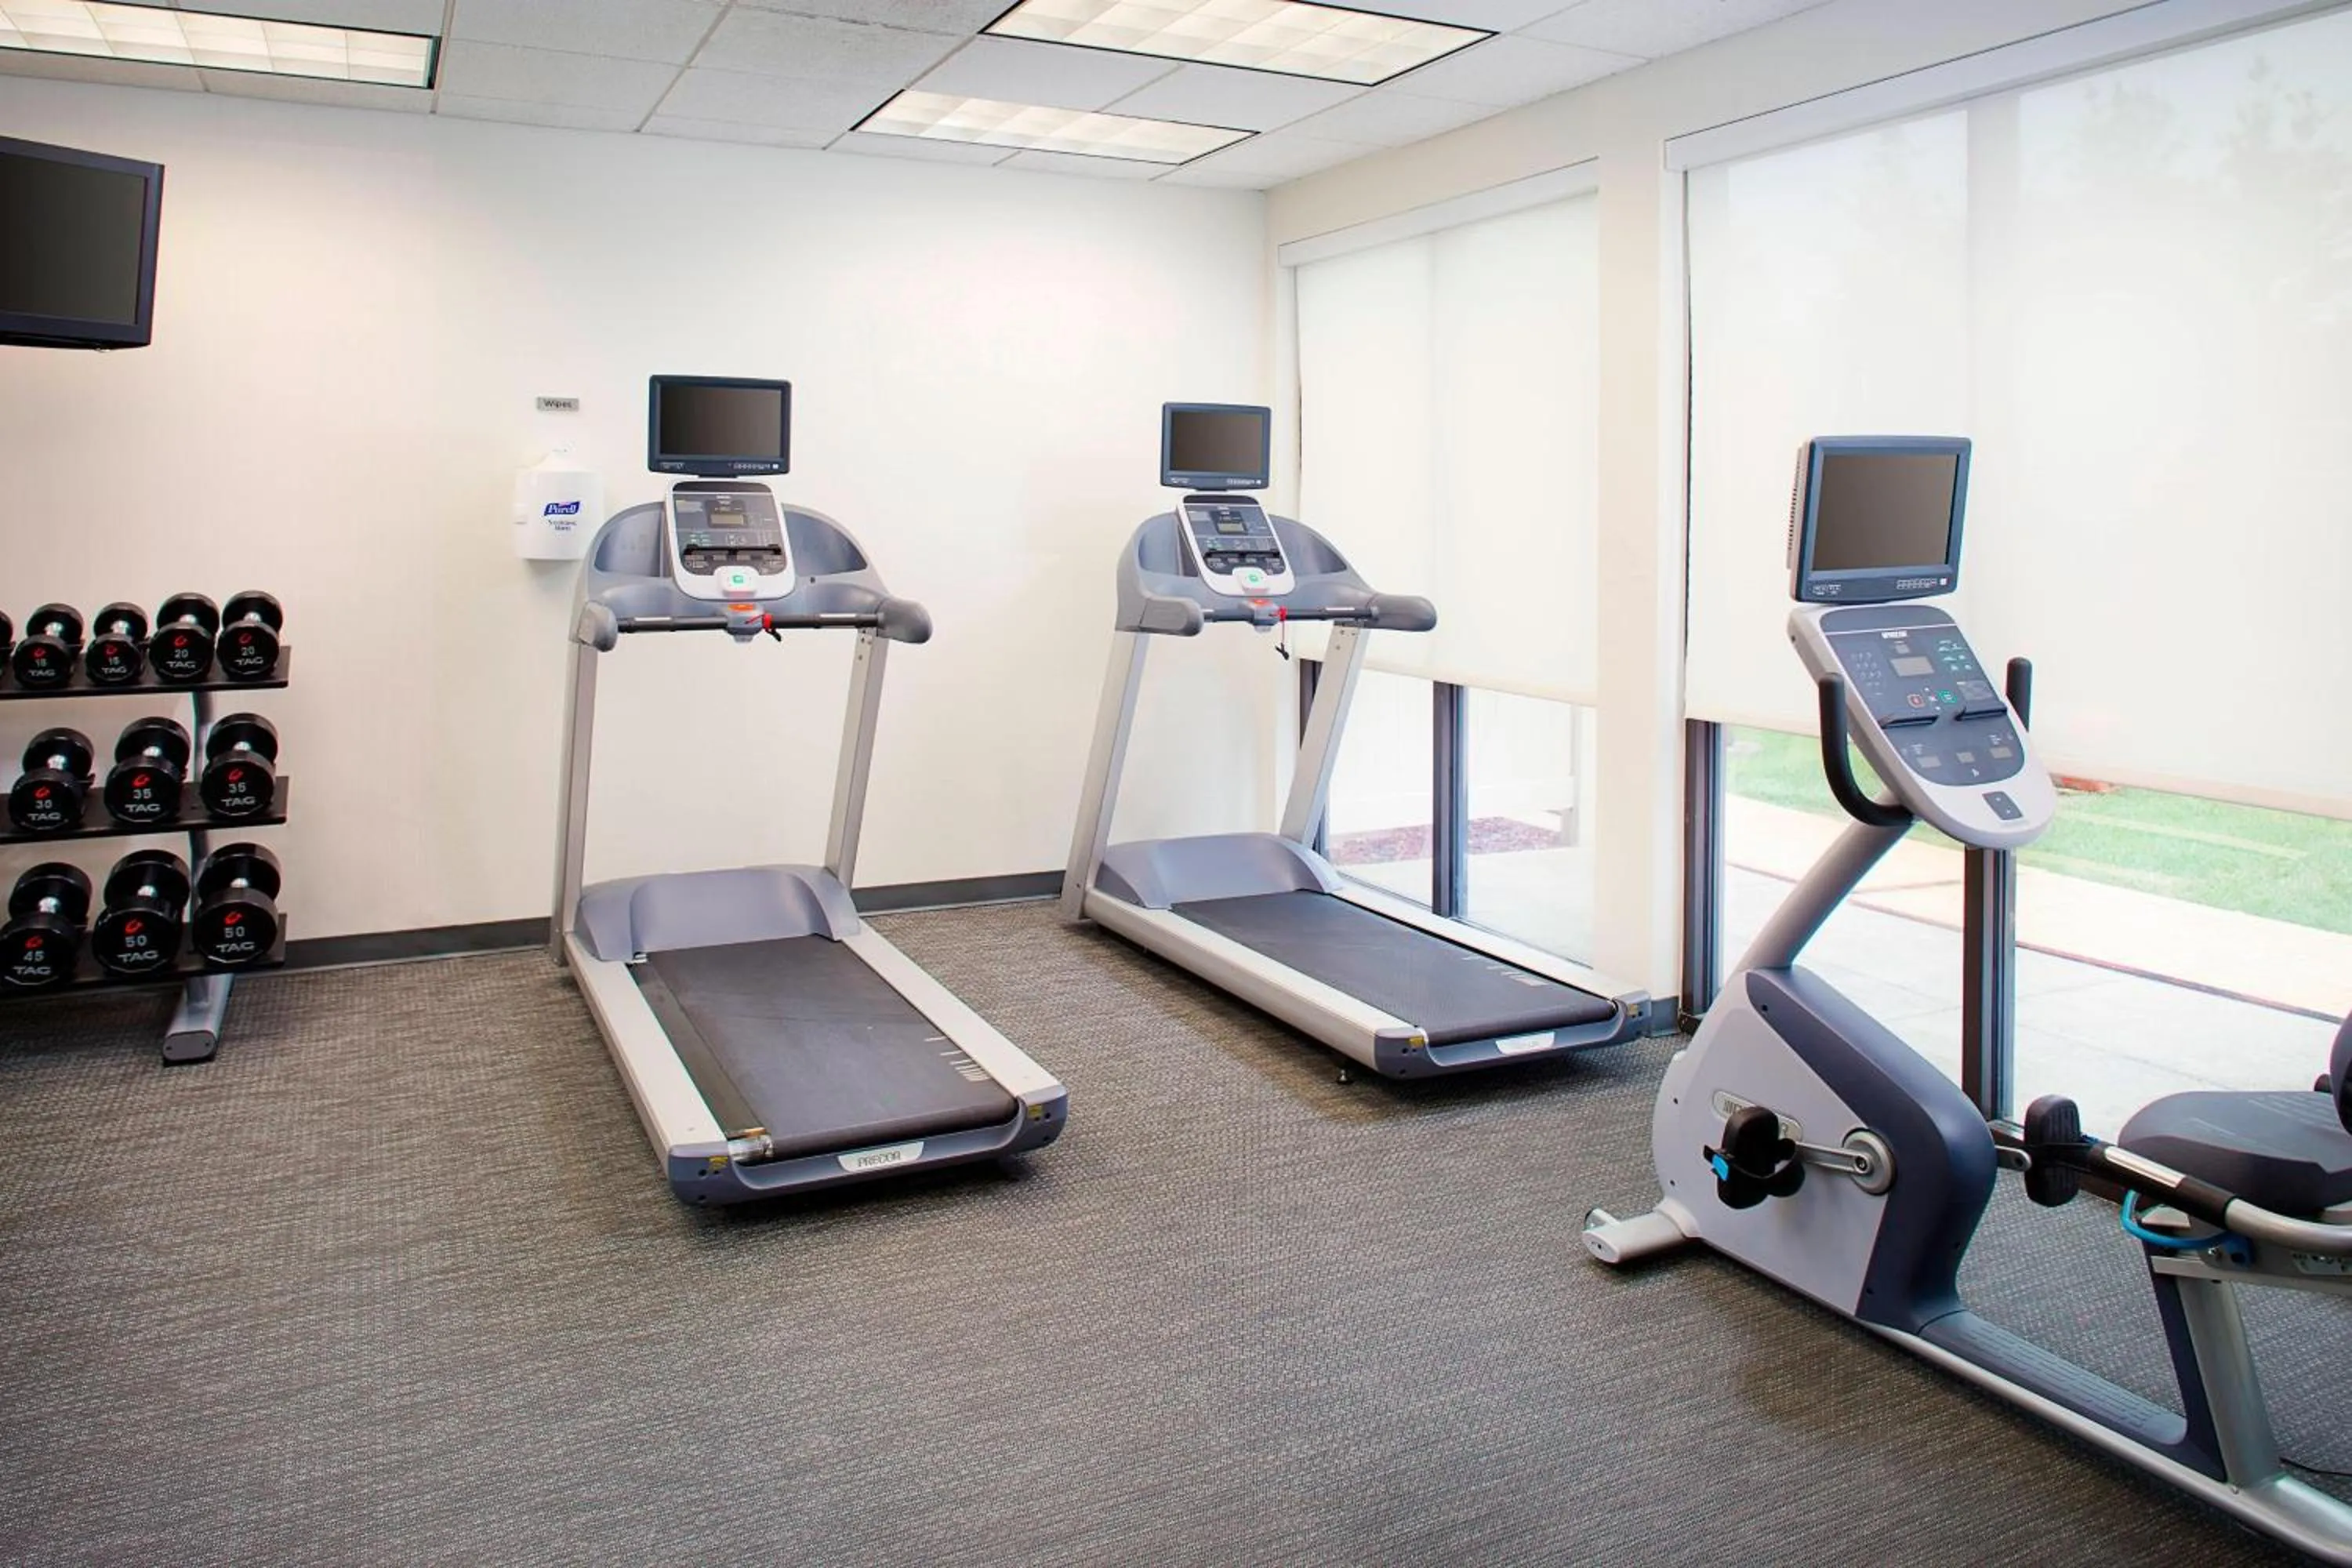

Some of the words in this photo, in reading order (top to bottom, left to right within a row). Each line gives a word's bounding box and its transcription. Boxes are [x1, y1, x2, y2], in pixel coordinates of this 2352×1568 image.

[174, 649, 189, 659] 20
[241, 646, 256, 656] 20
[234, 657, 263, 666] TAG
[228, 782, 246, 794] 35
[132, 788, 152, 800] 35
[221, 796, 256, 807] TAG
[125, 804, 161, 813] TAG
[27, 812, 61, 821] TAG
[224, 927, 245, 938] 50
[125, 935, 147, 947] 50
[216, 942, 255, 953] TAG
[23, 950, 45, 962] 45
[118, 951, 158, 963] TAG
[13, 966, 51, 976] TAG
[857, 1150, 901, 1167] PRECOR
